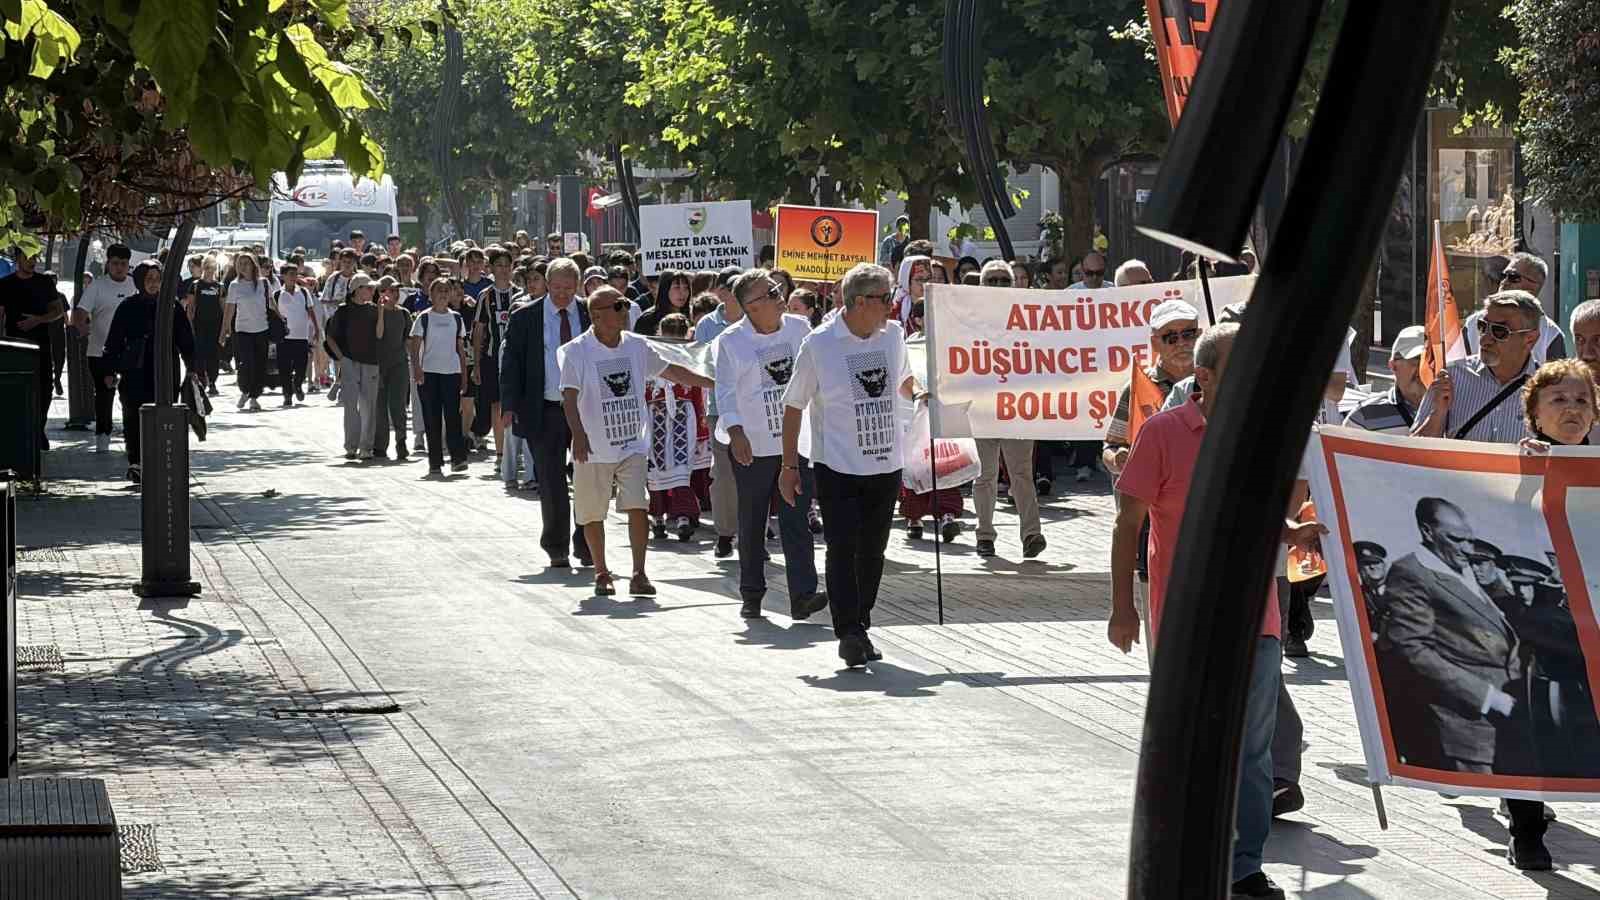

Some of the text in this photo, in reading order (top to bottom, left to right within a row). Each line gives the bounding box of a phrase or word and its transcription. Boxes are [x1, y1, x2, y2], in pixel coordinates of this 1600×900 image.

[300, 191, 328, 201] 112
[692, 235, 734, 247] BAYSAL
[646, 246, 749, 260] MESLEKİ ve TEKNİK
[782, 250, 806, 258] EMİNE
[807, 252, 838, 261] MEHMET
[655, 260, 705, 271] ANADOLU
[795, 265, 831, 274] ANADOLU
[948, 340, 1098, 383] DÜŞÜNCE
[996, 392, 1078, 421] BOLU
